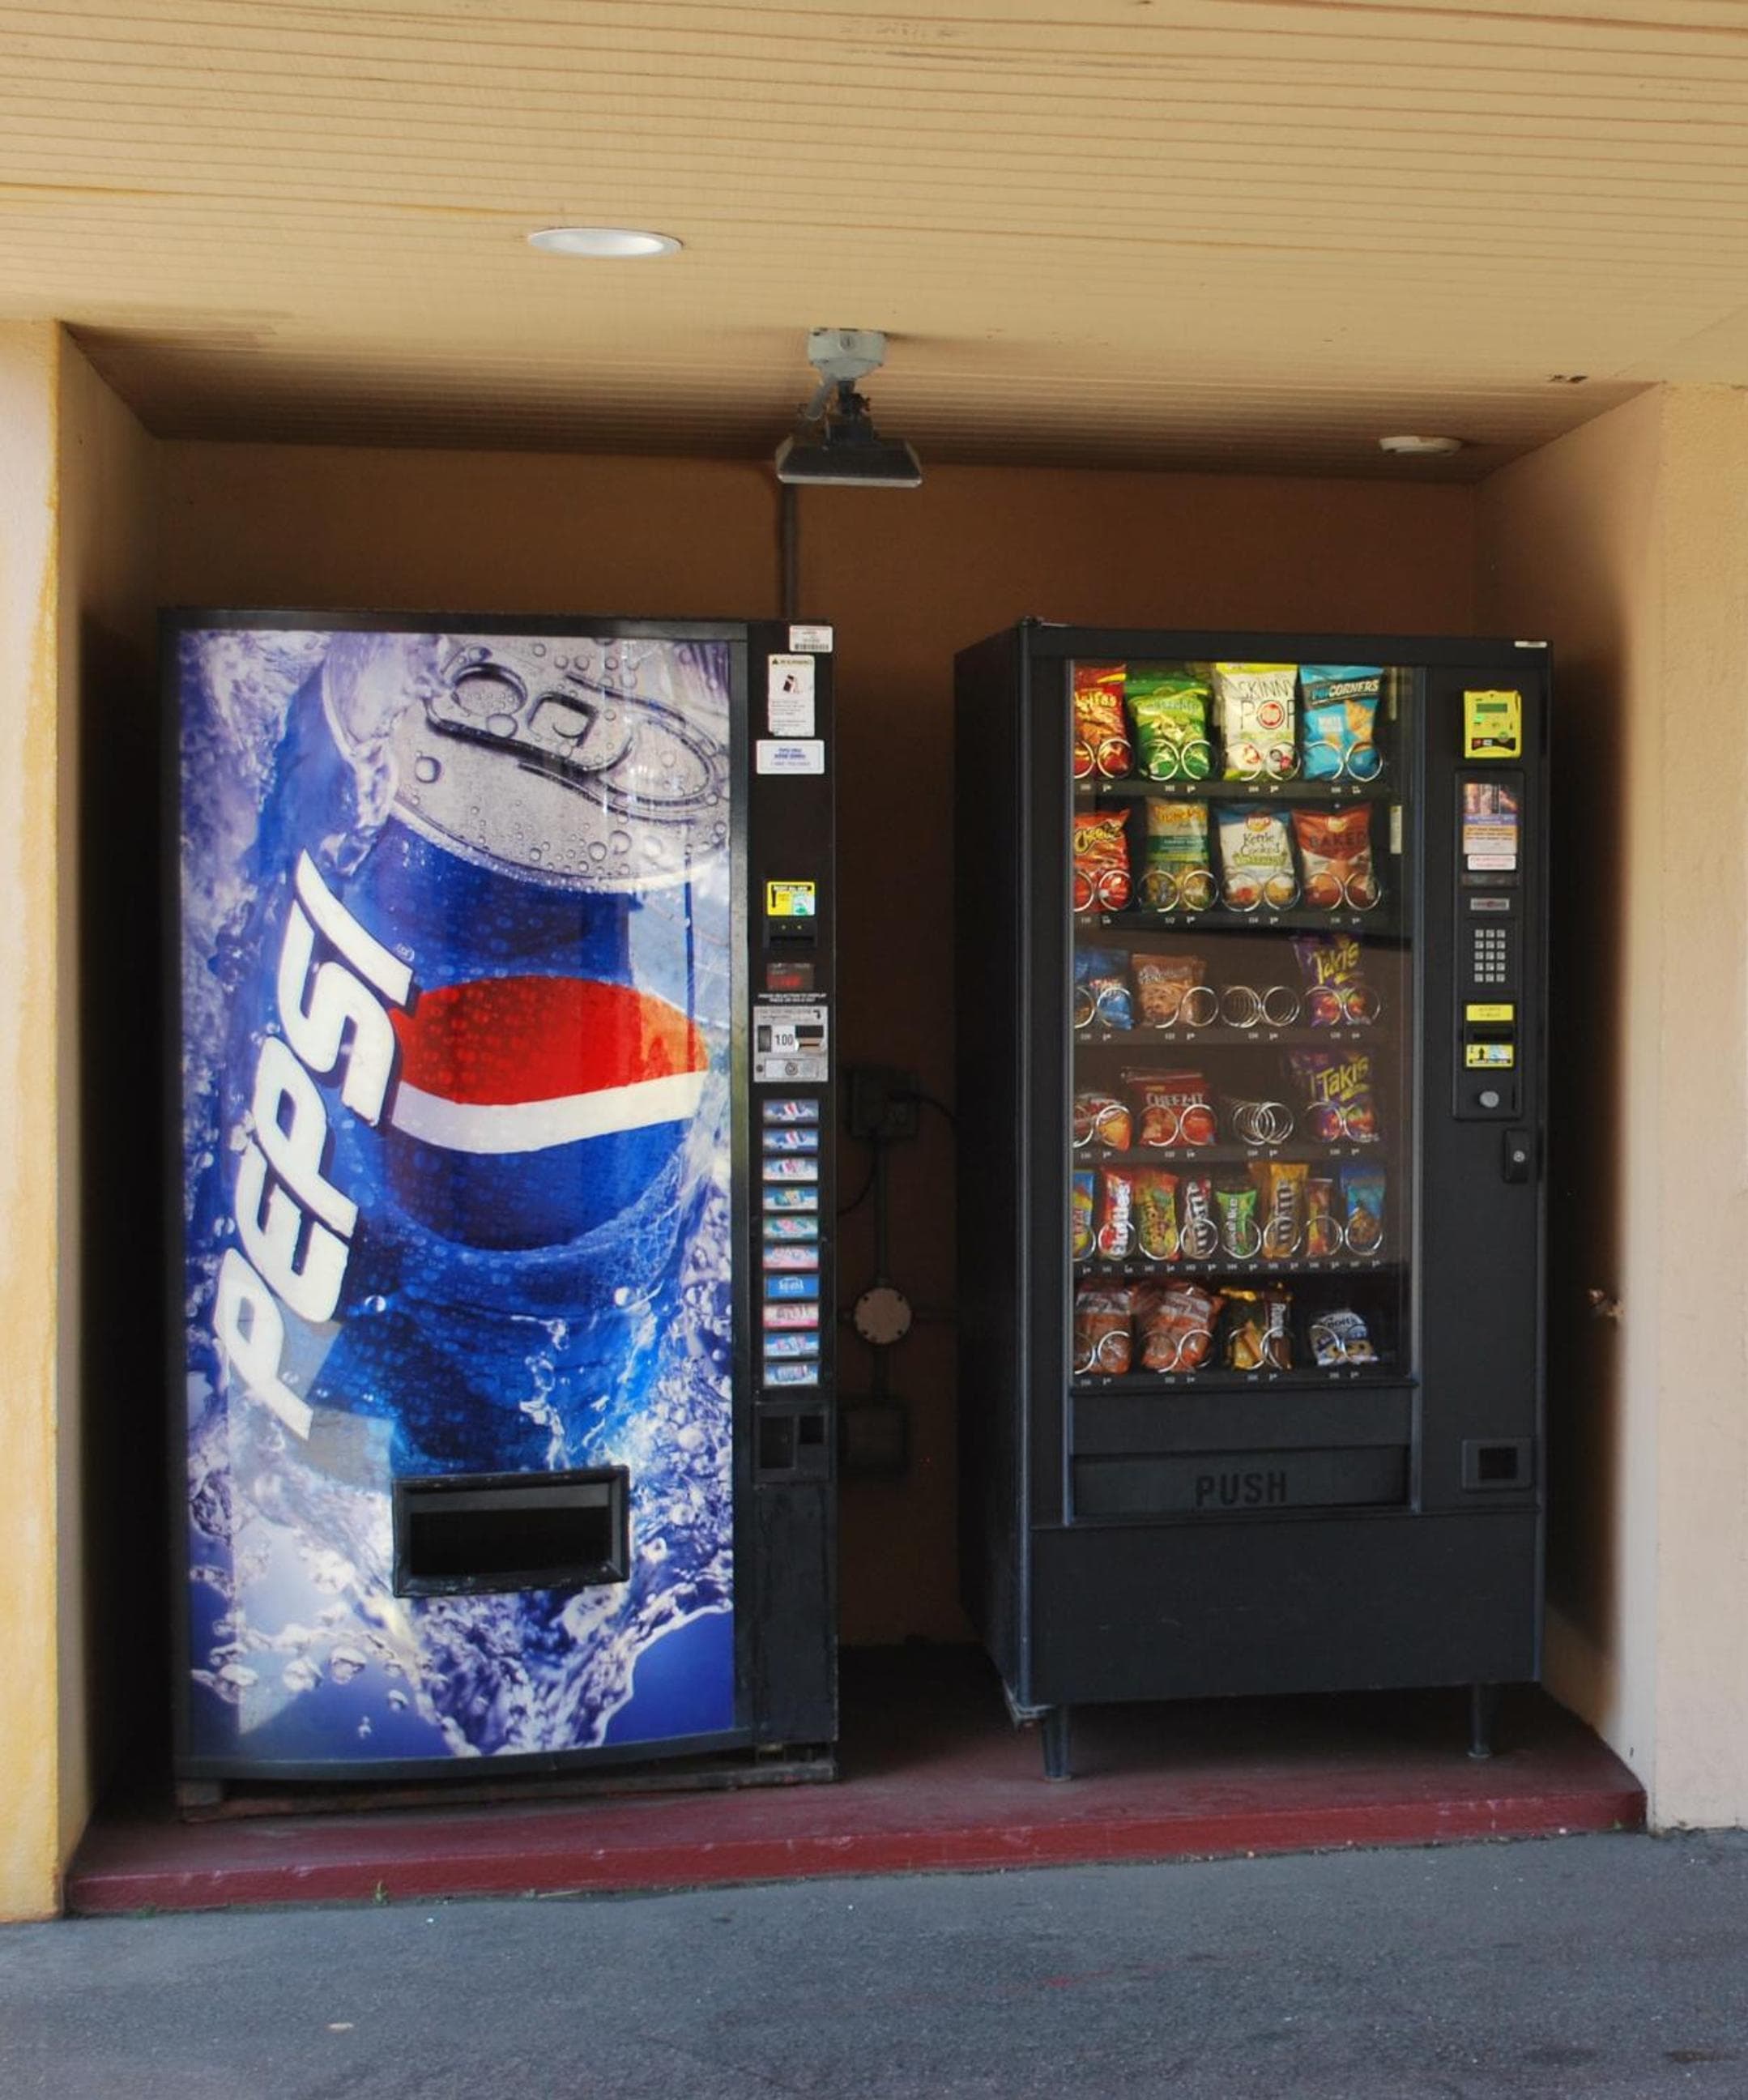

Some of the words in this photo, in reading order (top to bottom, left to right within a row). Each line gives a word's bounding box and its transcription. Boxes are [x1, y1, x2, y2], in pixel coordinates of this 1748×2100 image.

[1315, 1056, 1370, 1103] Takis
[214, 847, 413, 1441] PEPSI
[1195, 1470, 1287, 1508] PUSH
